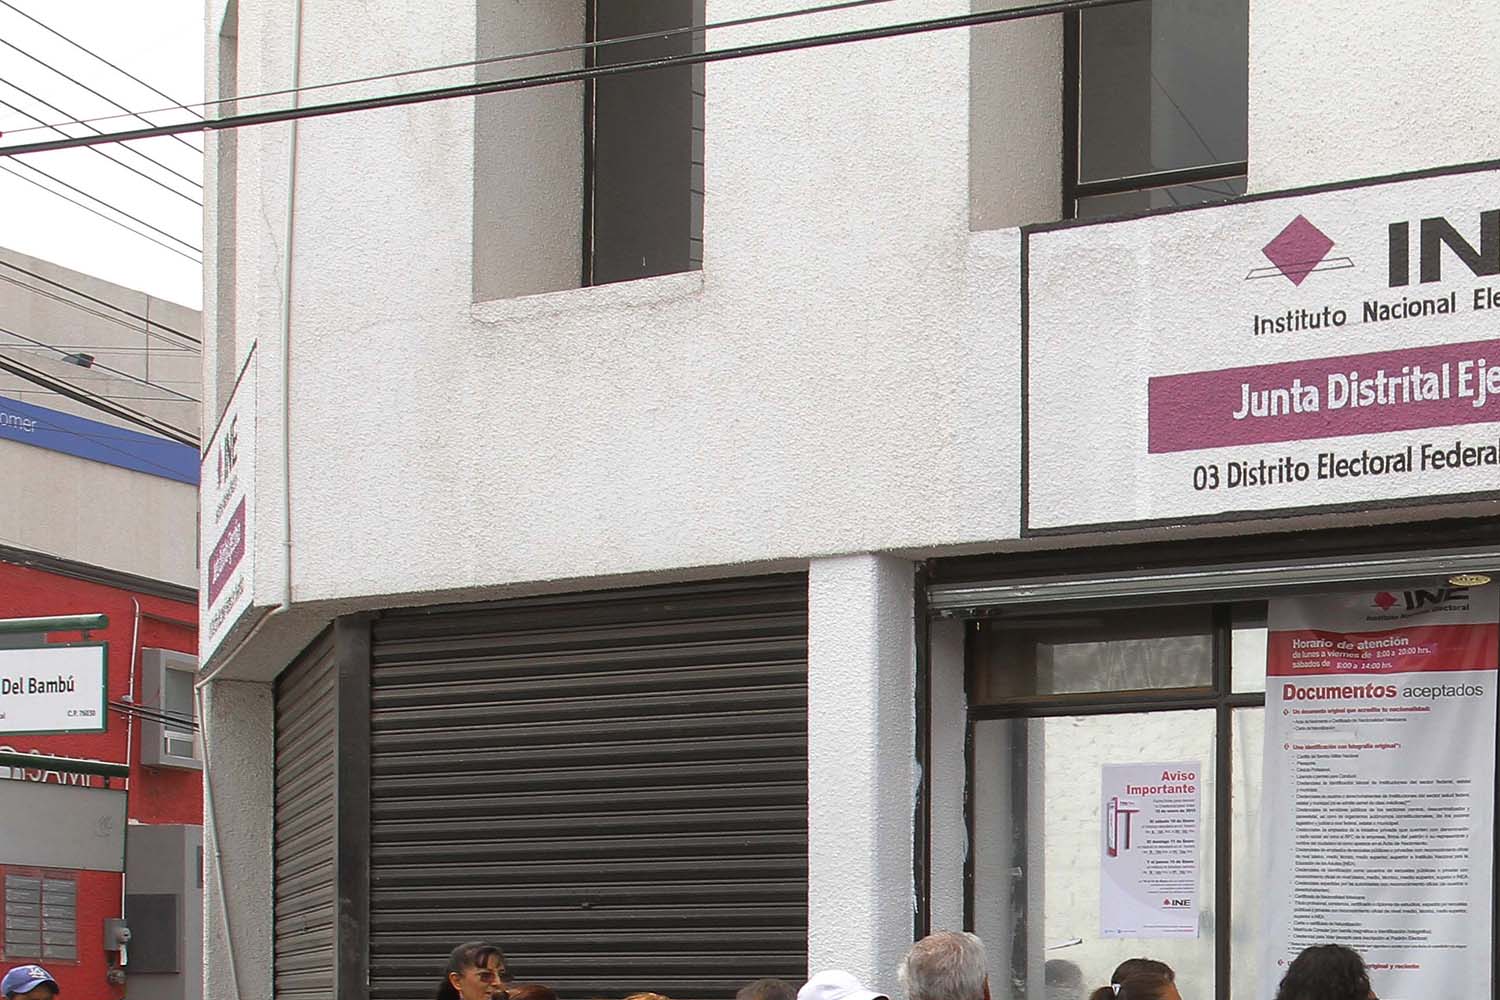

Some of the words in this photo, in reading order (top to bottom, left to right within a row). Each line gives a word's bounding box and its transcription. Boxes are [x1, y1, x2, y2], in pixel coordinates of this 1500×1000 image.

[1254, 304, 1347, 335] Instituto
[1362, 291, 1456, 324] Nacional
[1232, 381, 1320, 420] Junta
[1327, 367, 1452, 412] Distrital
[1193, 464, 1220, 493] 03
[1227, 456, 1310, 489] Distrito
[1317, 445, 1414, 481] Electoral
[1293, 639, 1333, 649] Horario
[1337, 641, 1354, 650] de
[1357, 637, 1409, 650] atención
[1, 677, 24, 695] Del
[28, 675, 75, 694] Bambú
[1283, 682, 1398, 701] Documentos
[1402, 682, 1484, 700] aceptados
[1161, 770, 1196, 782] Aviso
[1126, 784, 1196, 797] Importante
[1171, 899, 1191, 907] INE
